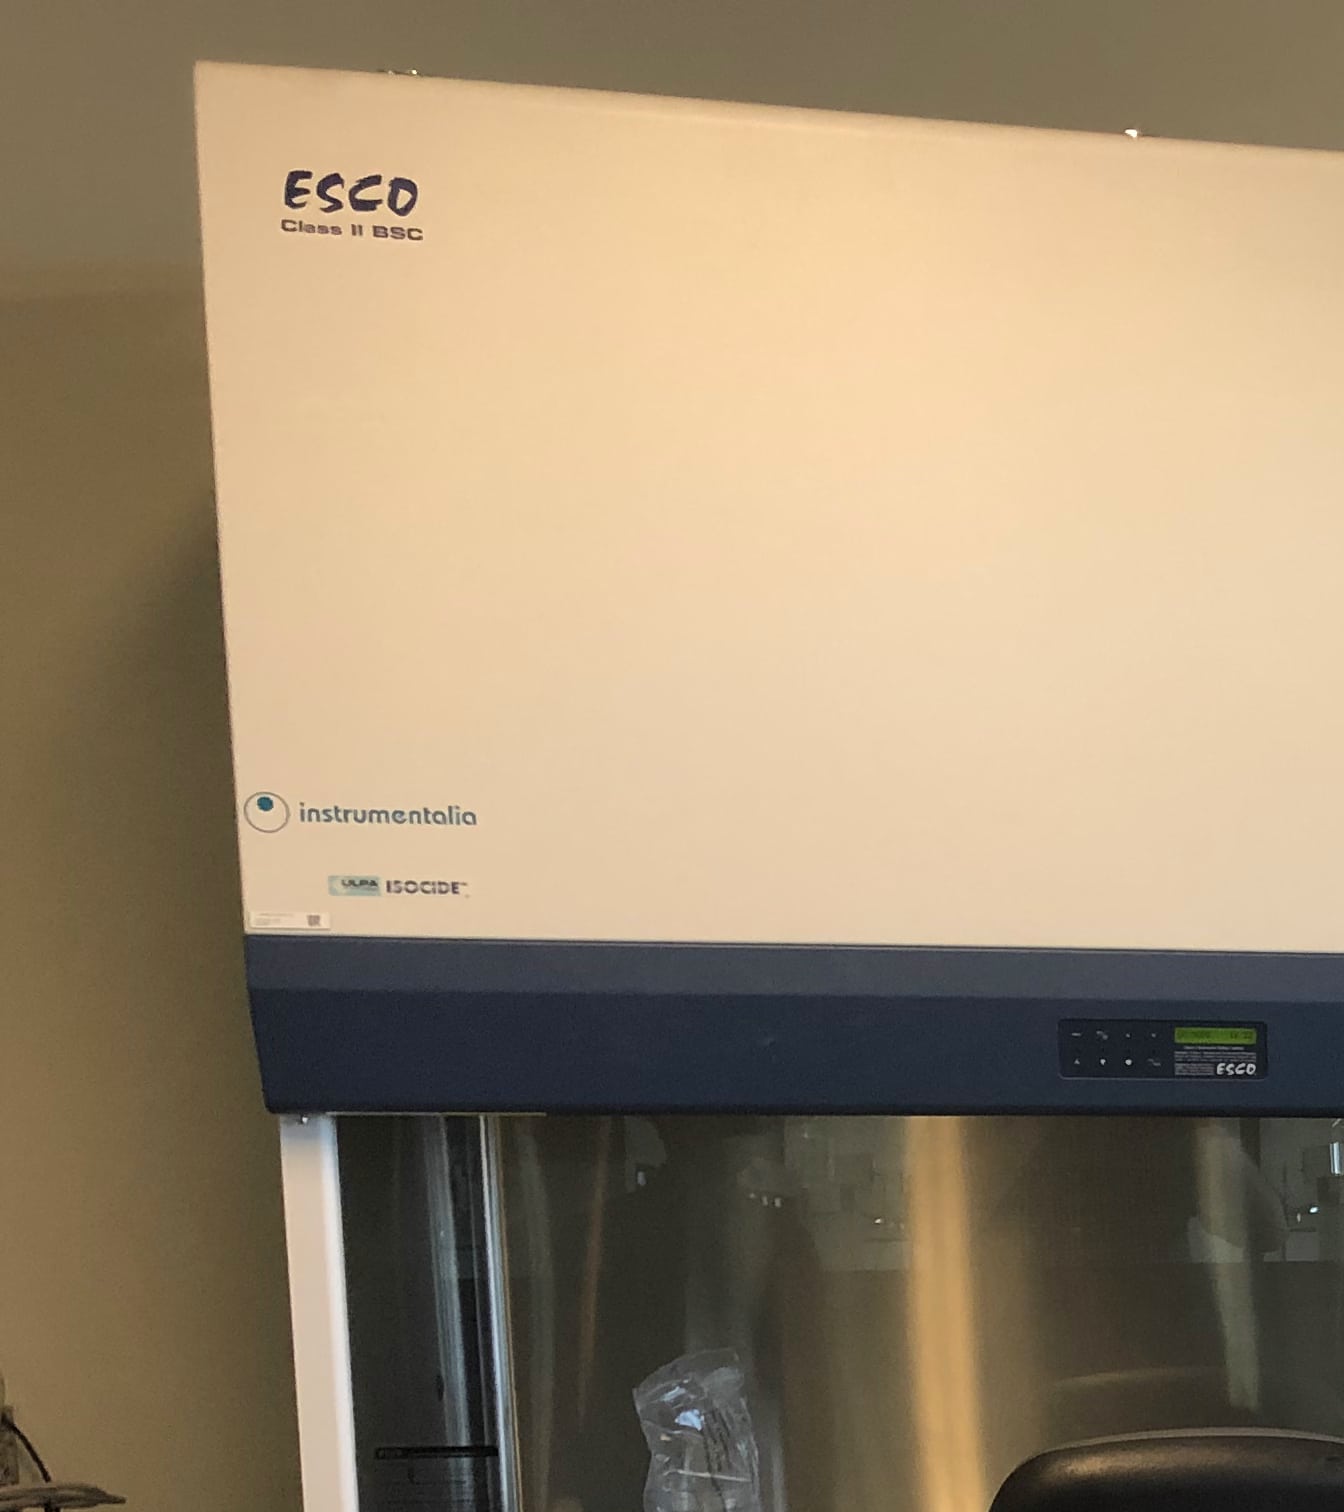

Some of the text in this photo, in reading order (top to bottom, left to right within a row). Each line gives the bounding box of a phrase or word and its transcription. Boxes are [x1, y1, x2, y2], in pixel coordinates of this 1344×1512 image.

[283, 169, 419, 217] ESCO
[280, 218, 343, 237] Class
[372, 224, 425, 242] BSC
[299, 801, 478, 826] instrumentalia
[385, 879, 461, 896] ISOCIDE
[1216, 1062, 1257, 1076] ESCO
